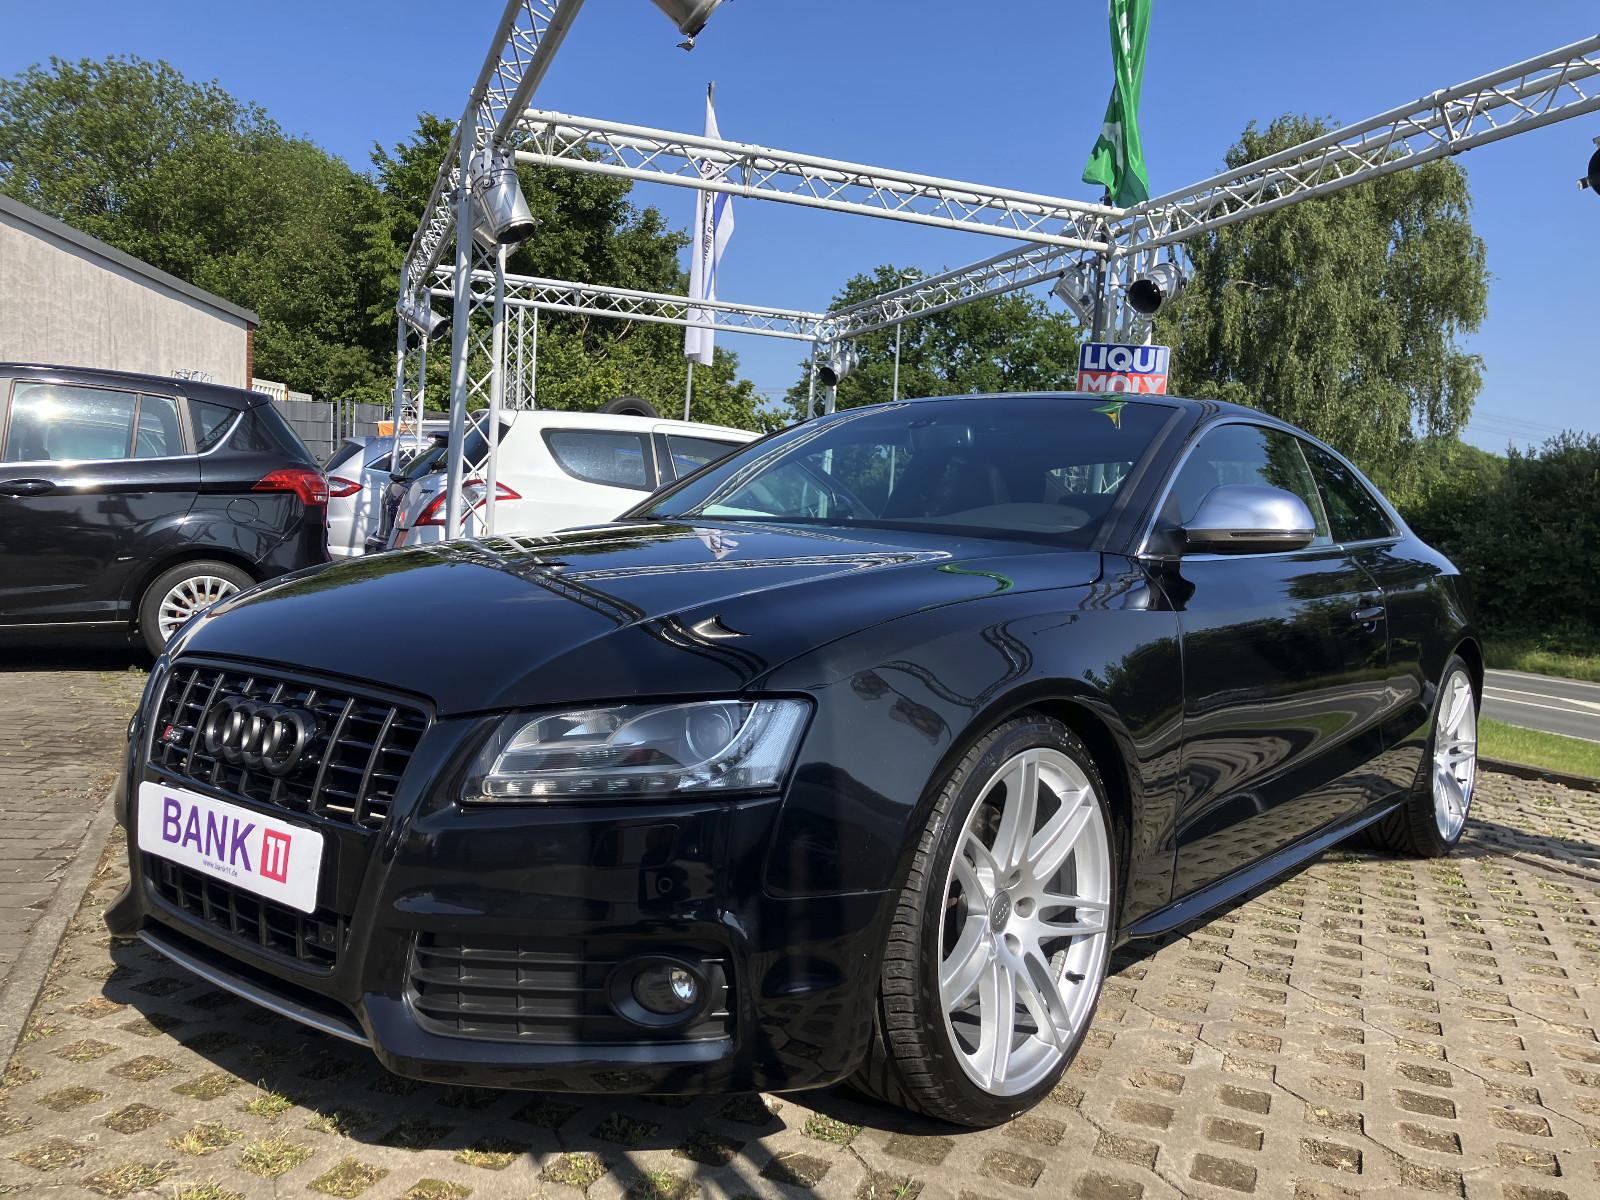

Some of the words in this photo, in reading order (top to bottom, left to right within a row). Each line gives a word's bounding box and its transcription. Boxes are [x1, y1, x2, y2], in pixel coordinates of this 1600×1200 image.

[1083, 346, 1165, 373] LIQUI
[1082, 374, 1165, 394] MOLY
[162, 796, 256, 872] BANK
[265, 834, 288, 878] 11
